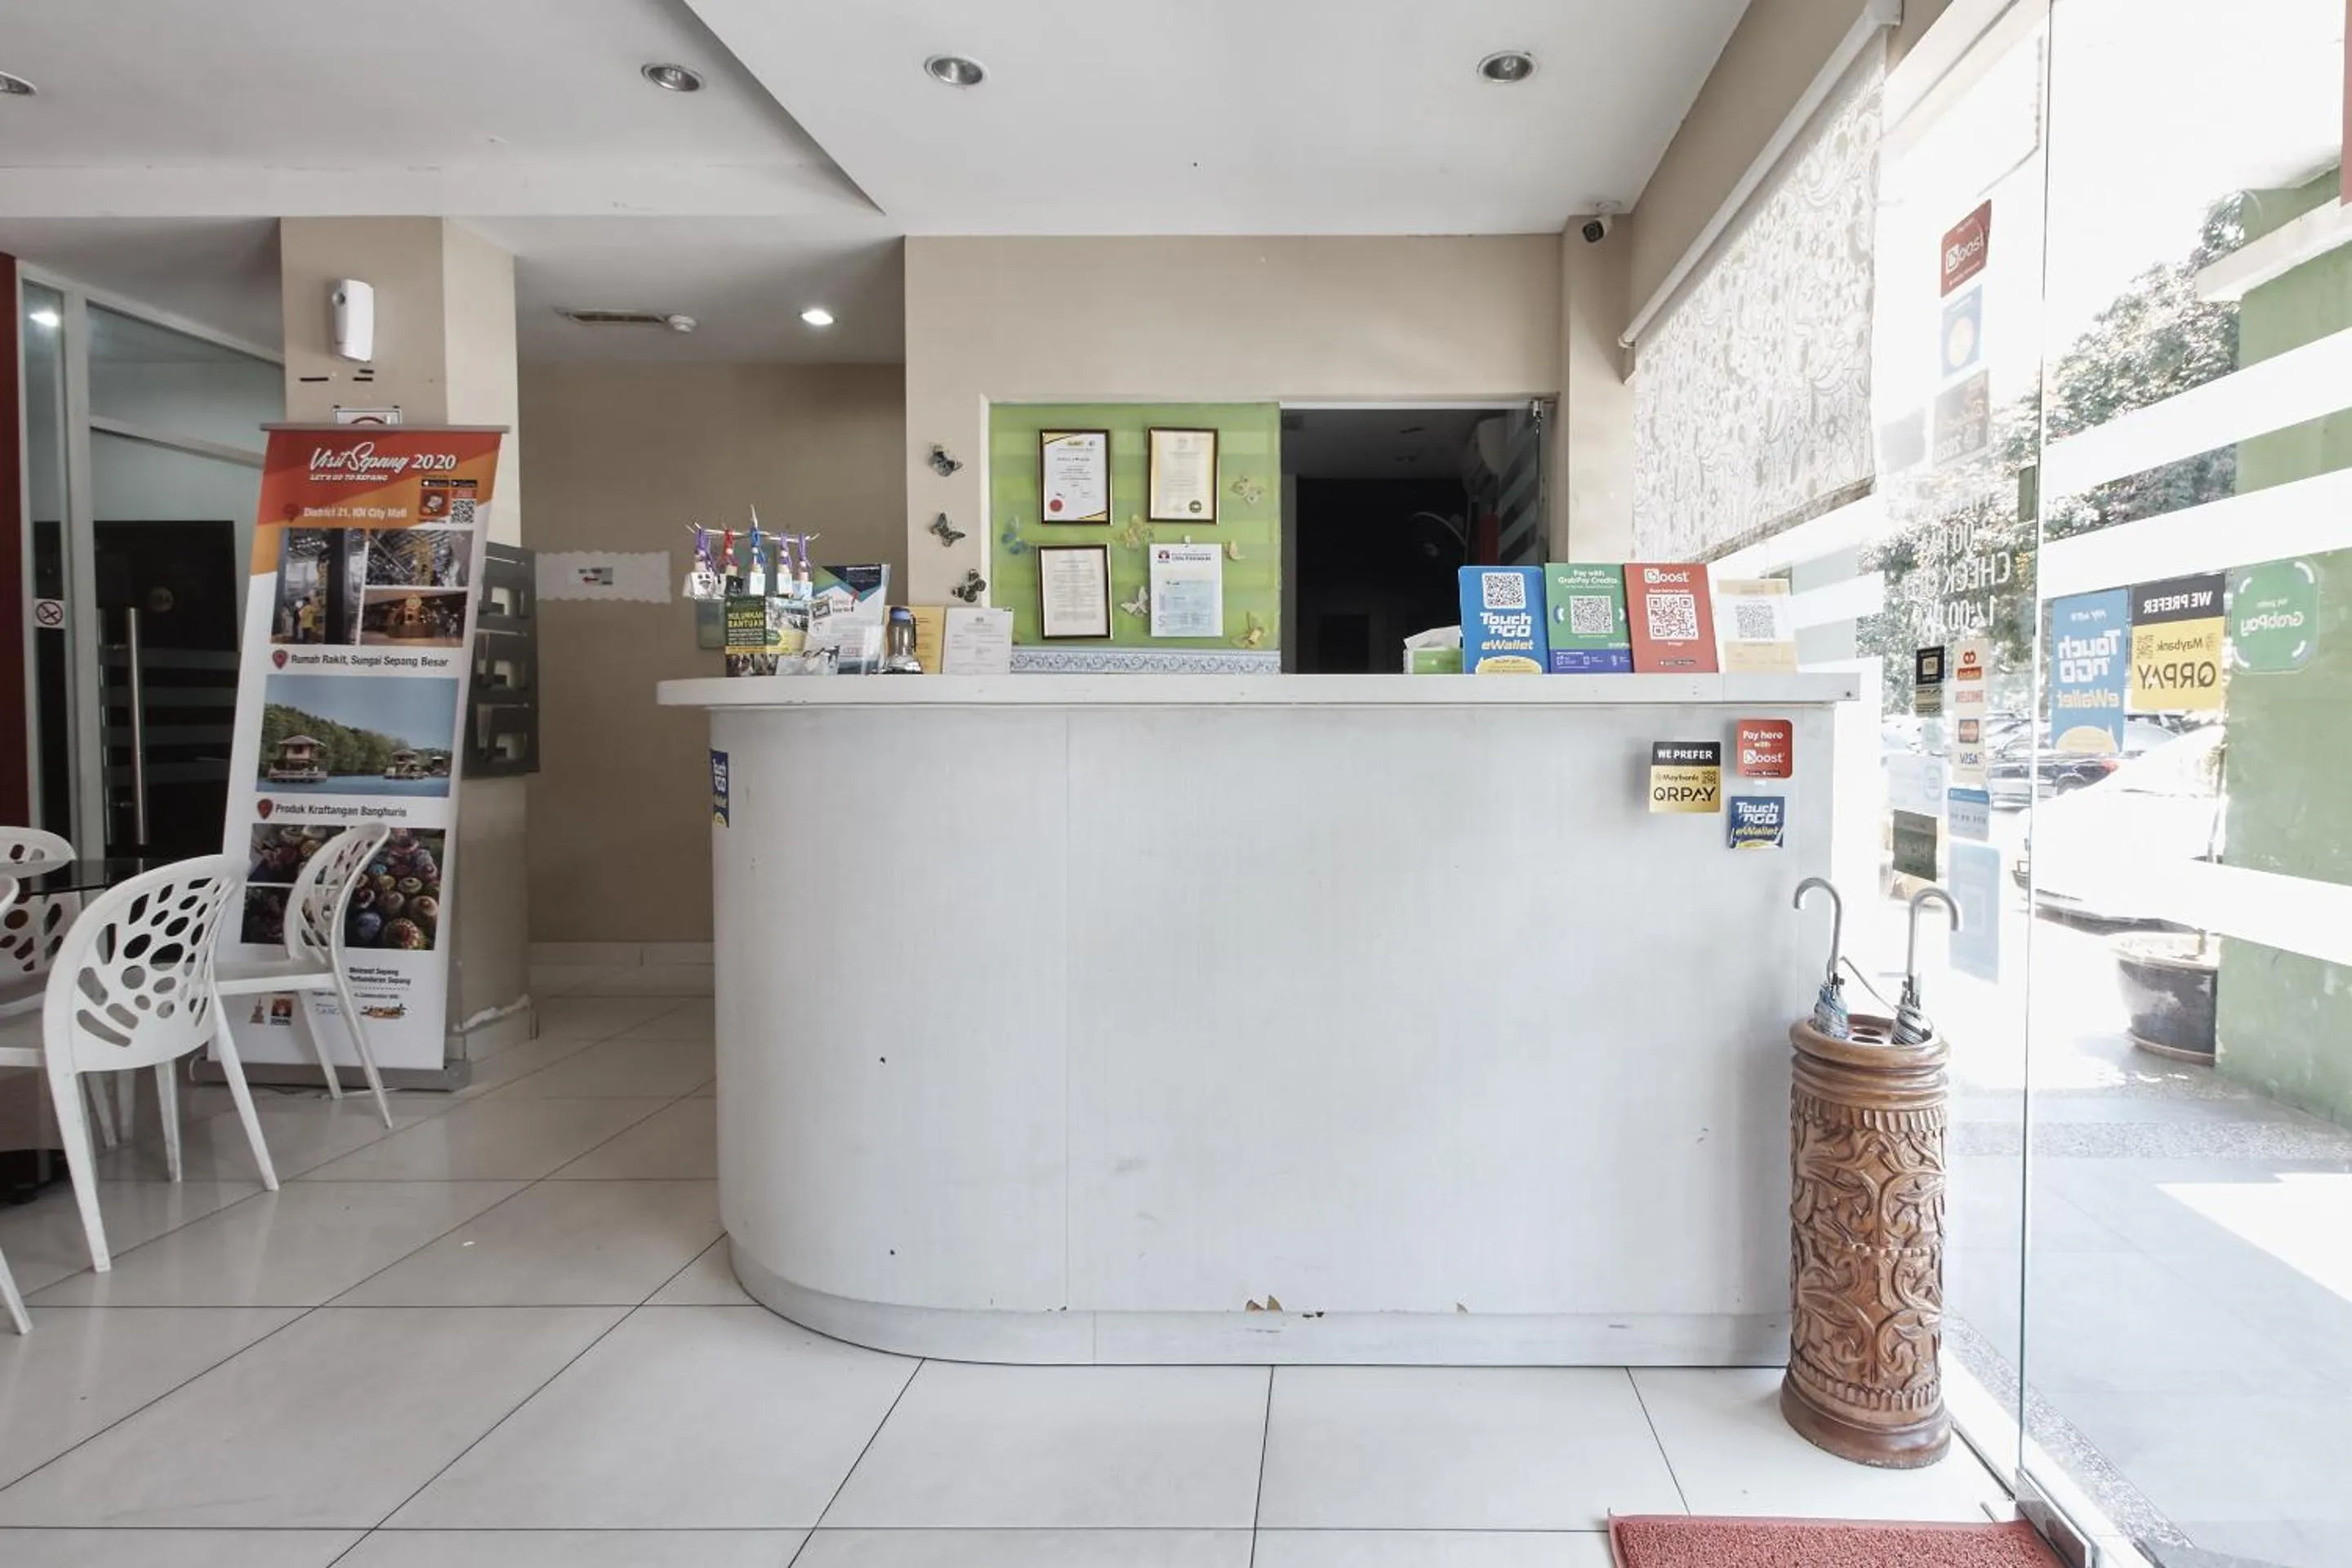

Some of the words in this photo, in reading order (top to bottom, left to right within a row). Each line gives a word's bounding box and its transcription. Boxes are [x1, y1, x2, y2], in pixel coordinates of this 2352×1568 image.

[310, 447, 350, 471] Visit
[348, 441, 410, 474] Sepang
[412, 453, 457, 470] 2020
[303, 506, 336, 518] District
[368, 508, 386, 520] City
[387, 508, 408, 519] Mall
[1573, 569, 1588, 577] Pay
[1588, 569, 1606, 577] with
[1557, 576, 1590, 585] GrabPay
[727, 620, 764, 628] BANTUAN
[1480, 612, 1532, 625] Touch
[1481, 639, 1535, 651] eWallet
[291, 654, 320, 664] Rumah
[350, 655, 381, 667] Sungai
[383, 656, 418, 668] Sepang
[421, 657, 449, 667] Besar
[1743, 730, 1758, 741] Pay
[1760, 730, 1784, 740] here
[1657, 749, 1672, 760] WE
[1673, 749, 1713, 760] PREFER
[1960, 752, 1979, 765] VISA
[1663, 773, 1699, 782] Maybank
[1654, 786, 1717, 803] QRPAY
[275, 804, 305, 814] Produk
[308, 804, 359, 817] Kraftangan
[360, 805, 407, 817] Banghuris
[1735, 802, 1779, 813] Touch
[1735, 826, 1779, 836] eWallet
